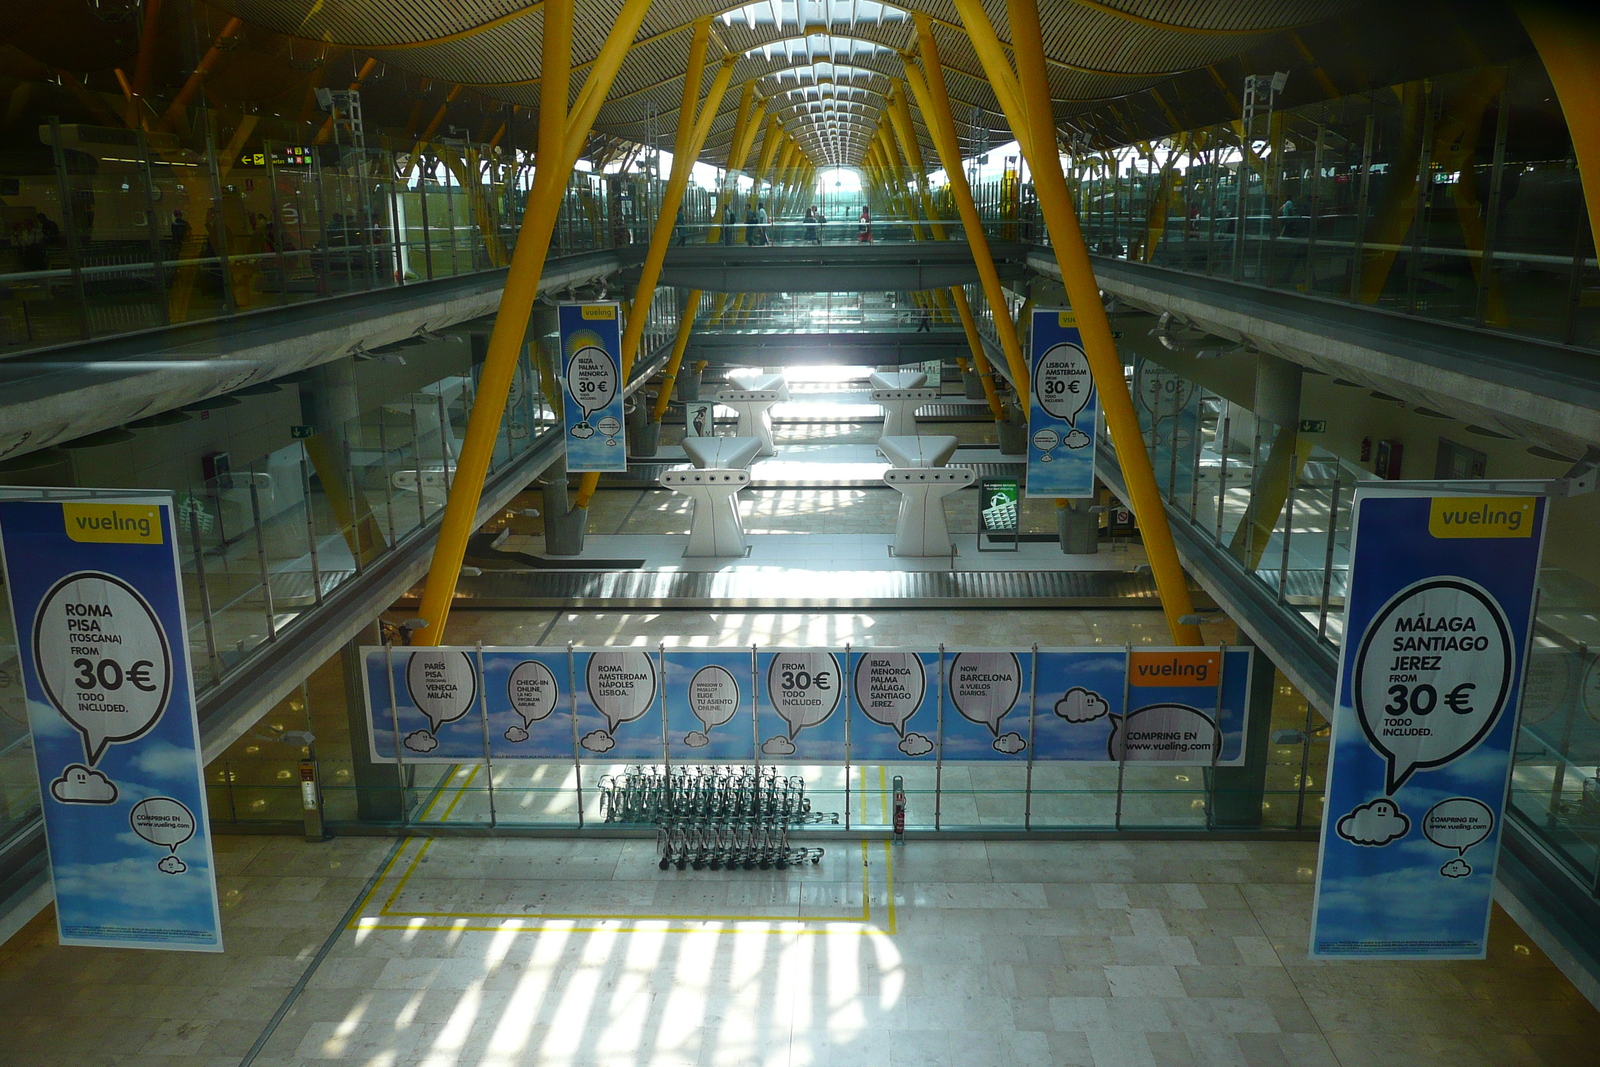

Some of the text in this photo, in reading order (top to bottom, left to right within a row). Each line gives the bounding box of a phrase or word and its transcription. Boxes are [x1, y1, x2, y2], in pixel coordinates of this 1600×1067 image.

[585, 308, 612, 317] vueling
[579, 381, 608, 392] 30 €
[1045, 380, 1080, 394] 30 €
[1442, 504, 1522, 530] vueling
[76, 511, 151, 536] vueling
[65, 604, 113, 618] ROMA
[68, 620, 101, 632] PISA
[1394, 612, 1476, 632] MÁLAGA
[70, 634, 122, 644] (TOSCANA)
[1392, 636, 1489, 652] SANTIAGO
[71, 647, 100, 656] FROM
[424, 662, 446, 670] PARÍS
[1138, 658, 1208, 680] vueling
[1390, 656, 1442, 671] JEREZ
[1389, 674, 1417, 682] FROM
[77, 692, 104, 702] TODO
[1384, 683, 1476, 716] 30 €
[78, 704, 129, 712] INCLUDED.
[1384, 718, 1412, 727] TODO
[1382, 728, 1433, 737] INCLUDED.
[1126, 742, 1210, 752] www.vueling.com
